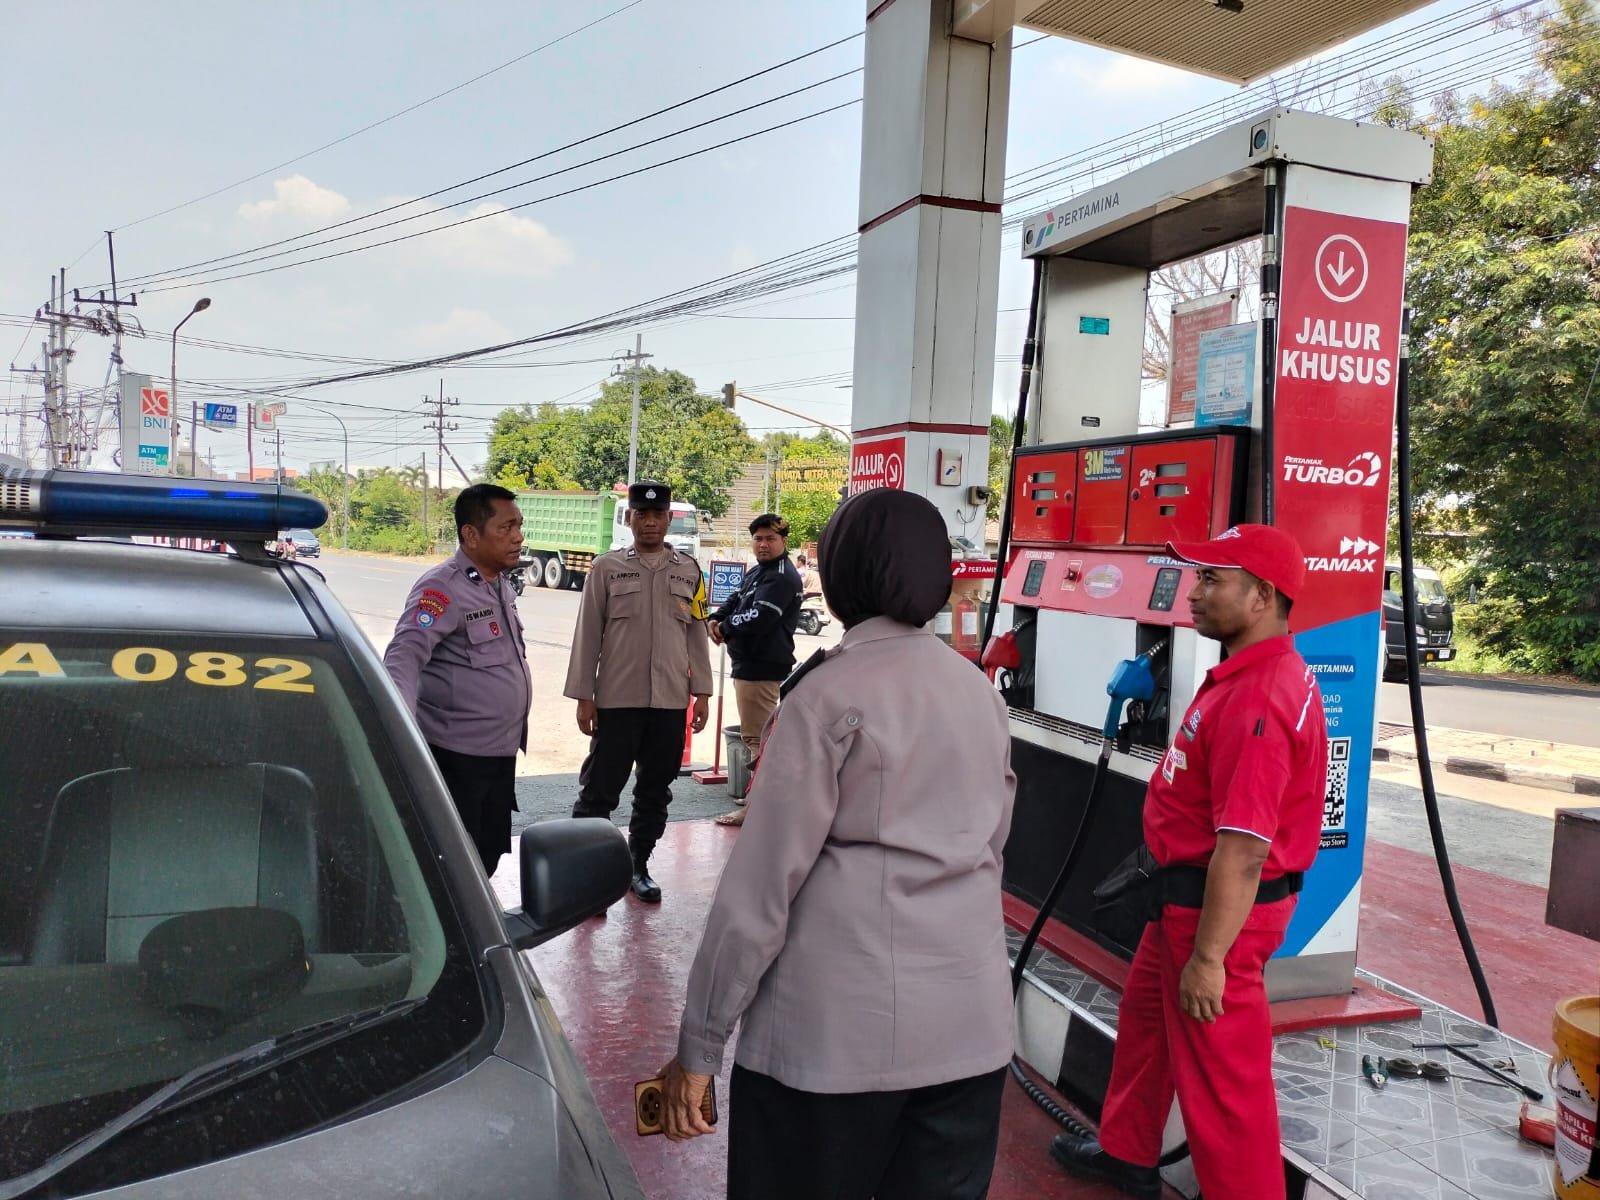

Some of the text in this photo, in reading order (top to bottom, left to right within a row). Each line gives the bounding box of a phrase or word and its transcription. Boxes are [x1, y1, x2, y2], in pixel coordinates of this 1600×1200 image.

[1057, 192, 1120, 230] PERTAMINA
[1295, 316, 1380, 351] JALUR
[1281, 349, 1391, 386] KHUSUS
[217, 406, 233, 414] ATM
[143, 416, 167, 429] BNI
[141, 447, 157, 455] ATM
[1284, 455, 1323, 465] PERTAMAX
[853, 453, 884, 476] JALUR
[1084, 450, 1104, 476] 3M
[1139, 468, 1150, 487] 2
[1283, 464, 1364, 486] TURBO
[731, 608, 759, 626] Grab
[111, 646, 315, 694] 082
[1307, 664, 1354, 673] PERTAMINA
[1331, 839, 1346, 847] Store
